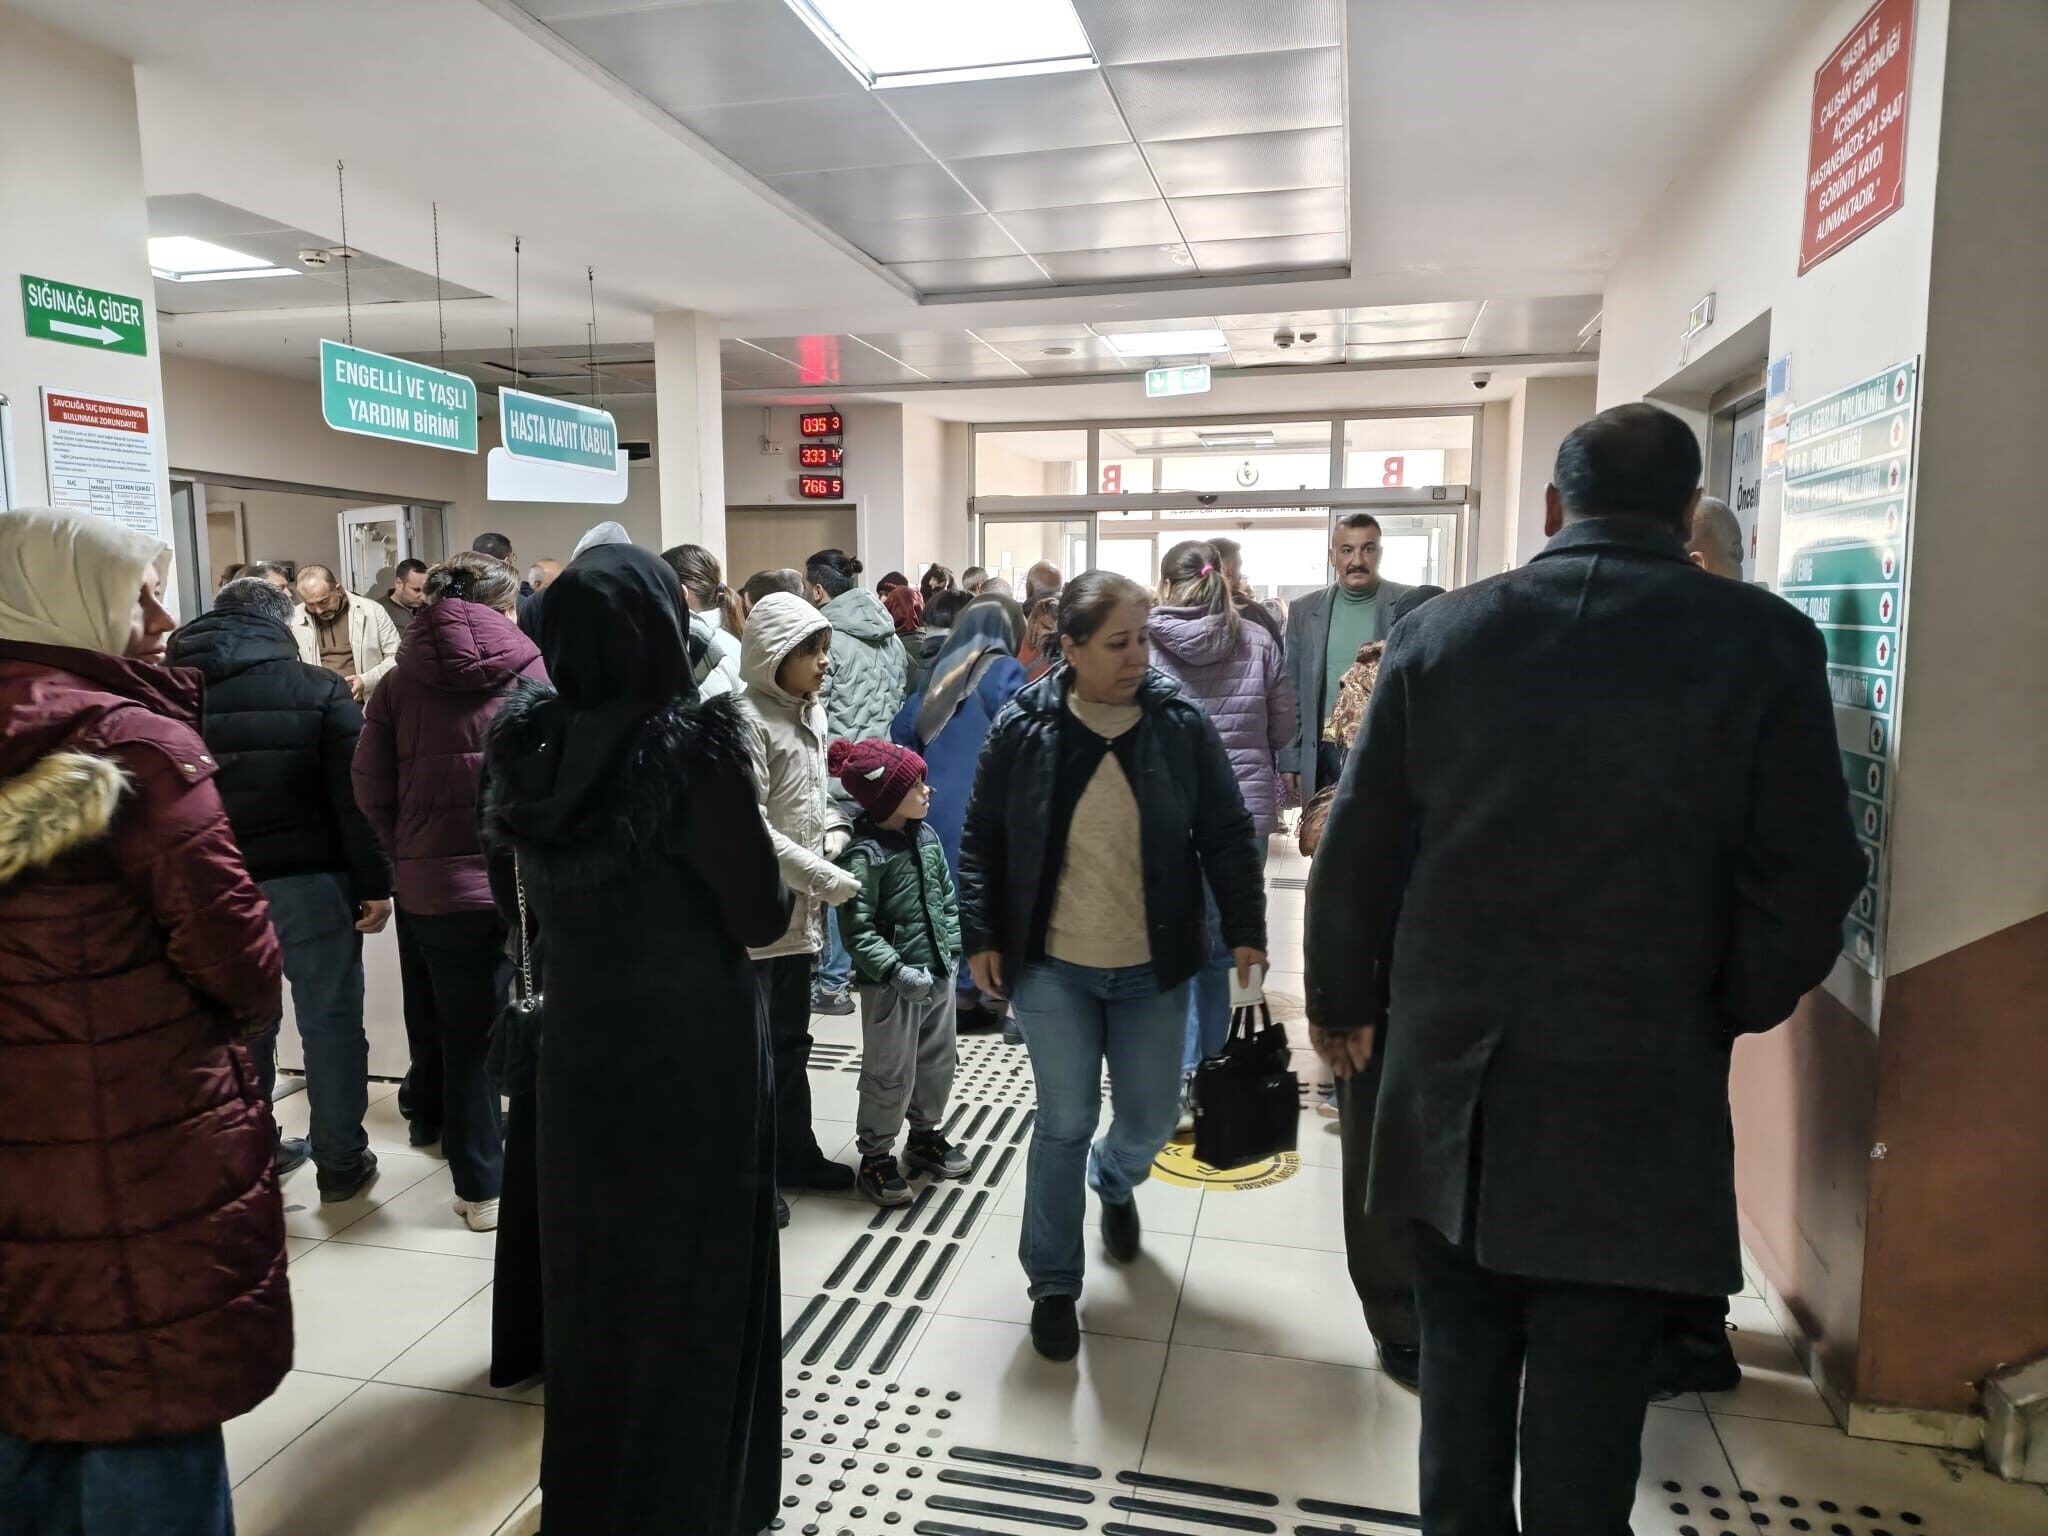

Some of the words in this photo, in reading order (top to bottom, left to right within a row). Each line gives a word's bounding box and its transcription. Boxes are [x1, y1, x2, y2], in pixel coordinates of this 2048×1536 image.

[1868, 18, 1881, 46] VE
[1820, 81, 1852, 132] ÇALIŞAN
[1852, 21, 1901, 93] GÜVENLİĞİ
[1833, 83, 1878, 144] AÇISINDAN
[1810, 132, 1864, 193] HASTANEMİZDE
[1866, 119, 1878, 142] 24
[1880, 91, 1904, 132] SAAT
[1819, 160, 1857, 212] GÖRÜNTÜ
[1858, 143, 1883, 182] KAYDI
[28, 282, 97, 319] SIĞINAĞA
[99, 295, 141, 327] GİDER
[335, 358, 402, 395] ENGELLİ
[406, 376, 425, 400] VE
[428, 381, 467, 411] YAŞLI
[1841, 377, 1889, 422] POLİKLİNİĞİ
[53, 398, 85, 411] SAVCILIĞA
[86, 402, 98, 413] SUÇ
[99, 405, 145, 419] DUYURUSUNDA
[63, 412, 99, 424] BULUNMAK
[99, 417, 138, 429] ZORUNDAYIZ
[347, 397, 410, 431] YARDIM
[415, 408, 460, 441] BİRİMİ
[832, 416, 840, 429] 3
[509, 409, 547, 442] HASTA
[549, 417, 578, 448] KAYIT
[580, 422, 613, 456] KABUL
[1811, 429, 1862, 470] POLİKLİNİĞİ
[802, 449, 827, 463] 333
[802, 479, 827, 493] 766
[832, 480, 840, 492] 5
